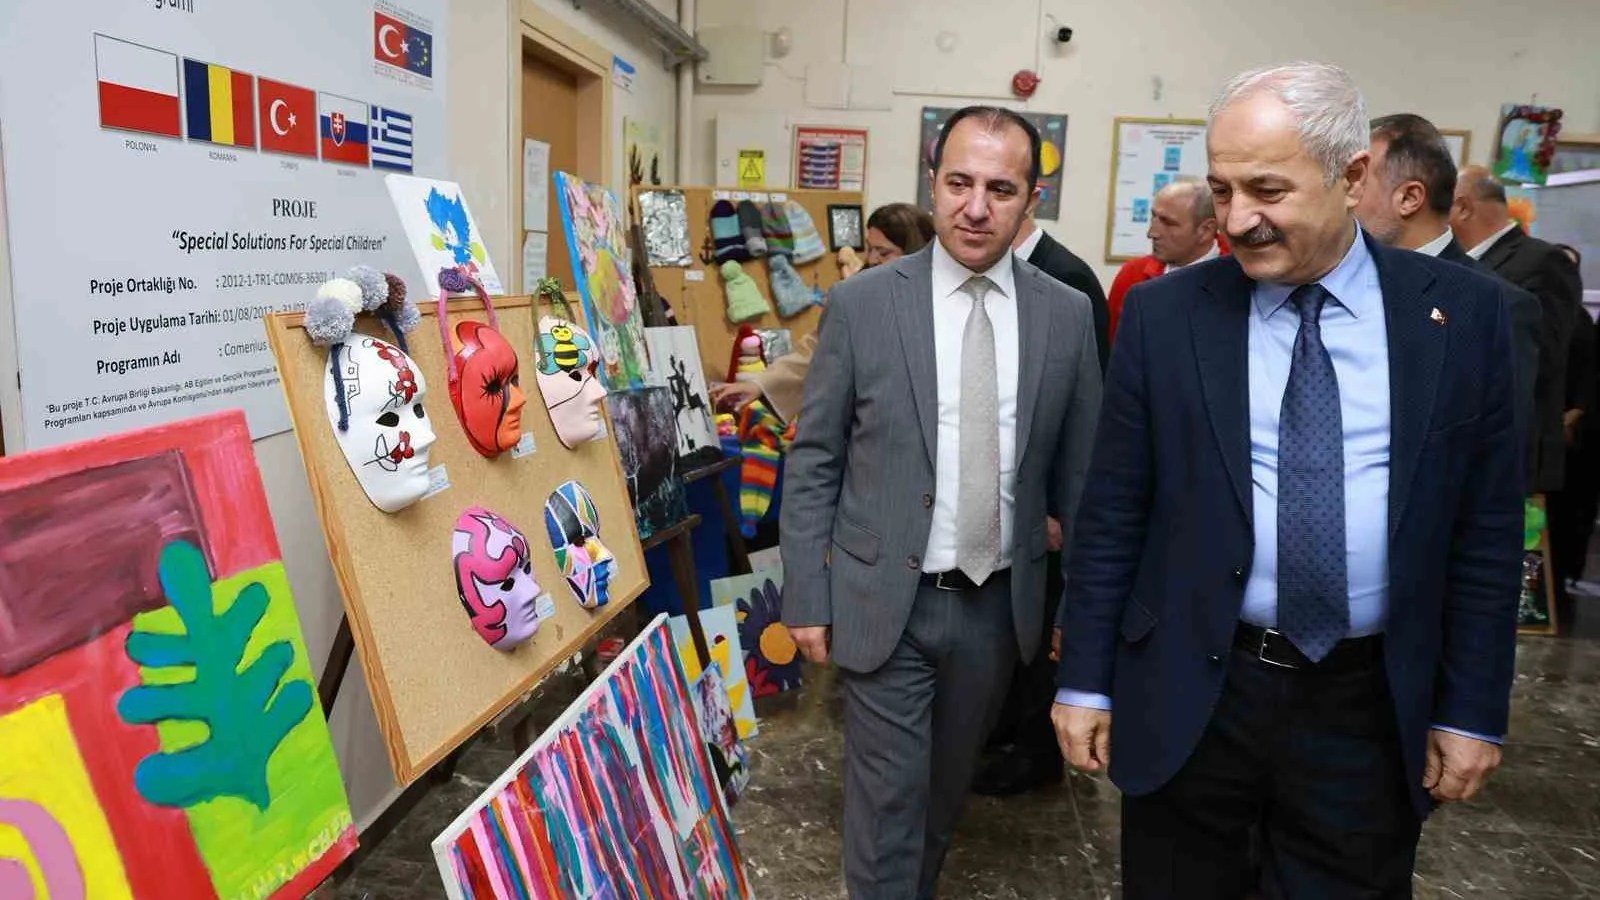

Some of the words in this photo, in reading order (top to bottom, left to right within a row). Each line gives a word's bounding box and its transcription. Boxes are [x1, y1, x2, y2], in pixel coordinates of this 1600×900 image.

[125, 140, 157, 152] POLONYA
[272, 198, 317, 219] PROJE
[232, 231, 286, 251] Solutions
[290, 234, 308, 251] For
[309, 234, 344, 253] Special
[90, 278, 123, 296] Proje
[126, 277, 176, 293] Ortaklığı
[178, 276, 197, 290] No.
[93, 318, 126, 336] Proje
[129, 314, 186, 334] Uygulama
[188, 310, 221, 325] Tarihi:
[97, 356, 160, 374] Programın
[163, 351, 181, 365] Adı
[224, 341, 267, 356] Comenius
[62, 400, 83, 413] proje
[102, 393, 128, 404] Avrupa
[184, 380, 194, 389] AB
[148, 398, 171, 409] Avrupa
